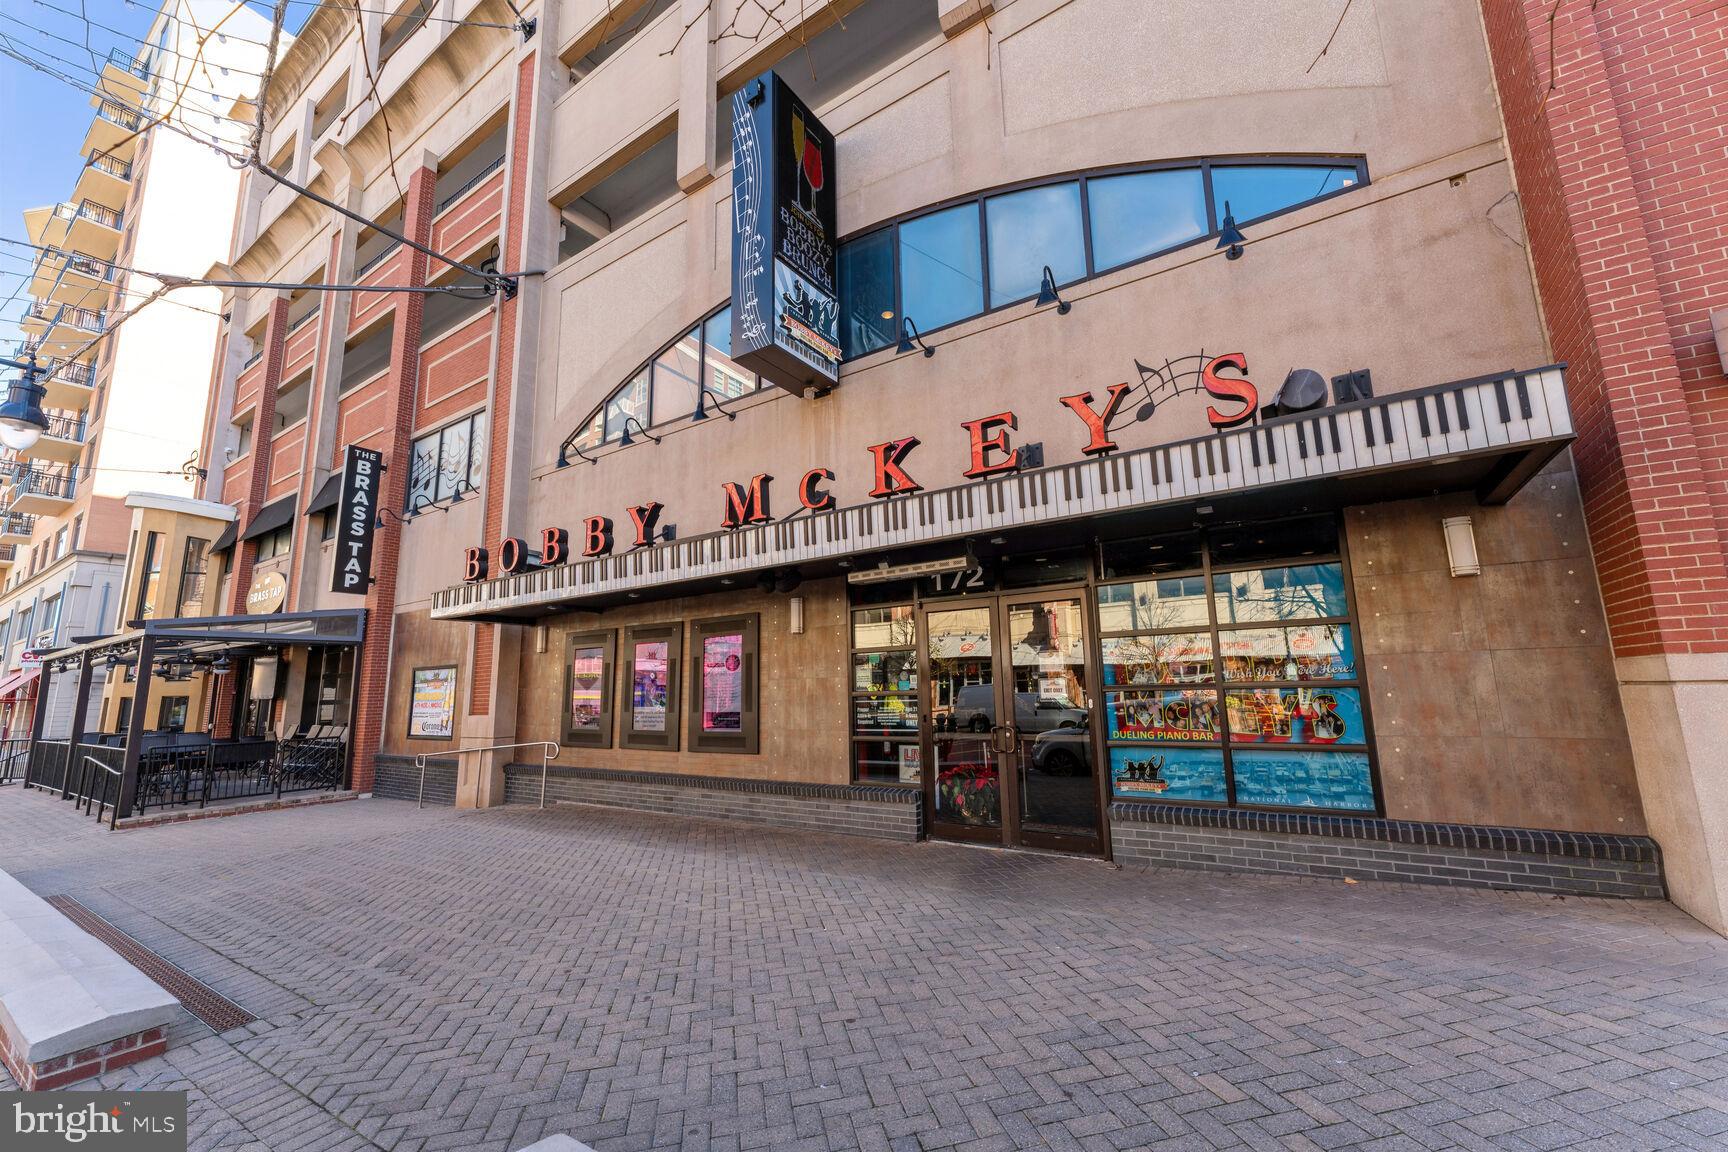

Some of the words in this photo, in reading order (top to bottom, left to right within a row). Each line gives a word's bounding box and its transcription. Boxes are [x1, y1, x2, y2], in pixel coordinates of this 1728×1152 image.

[783, 239, 832, 290] BRUNCH
[787, 226, 829, 268] BOOZY
[354, 449, 377, 461] THE
[350, 459, 372, 536] BRASS
[464, 501, 664, 581] BOBBY
[344, 541, 363, 588] TAP
[1226, 666, 1253, 679] Wish
[1255, 666, 1281, 682] You
[1318, 661, 1355, 674] Here!
[1112, 730, 1155, 740] DUELING
[1157, 731, 1190, 741] PIANO
[1192, 732, 1214, 741] BAR
[1243, 795, 1293, 805] NATIONAL
[1325, 801, 1368, 809] HARBOR
